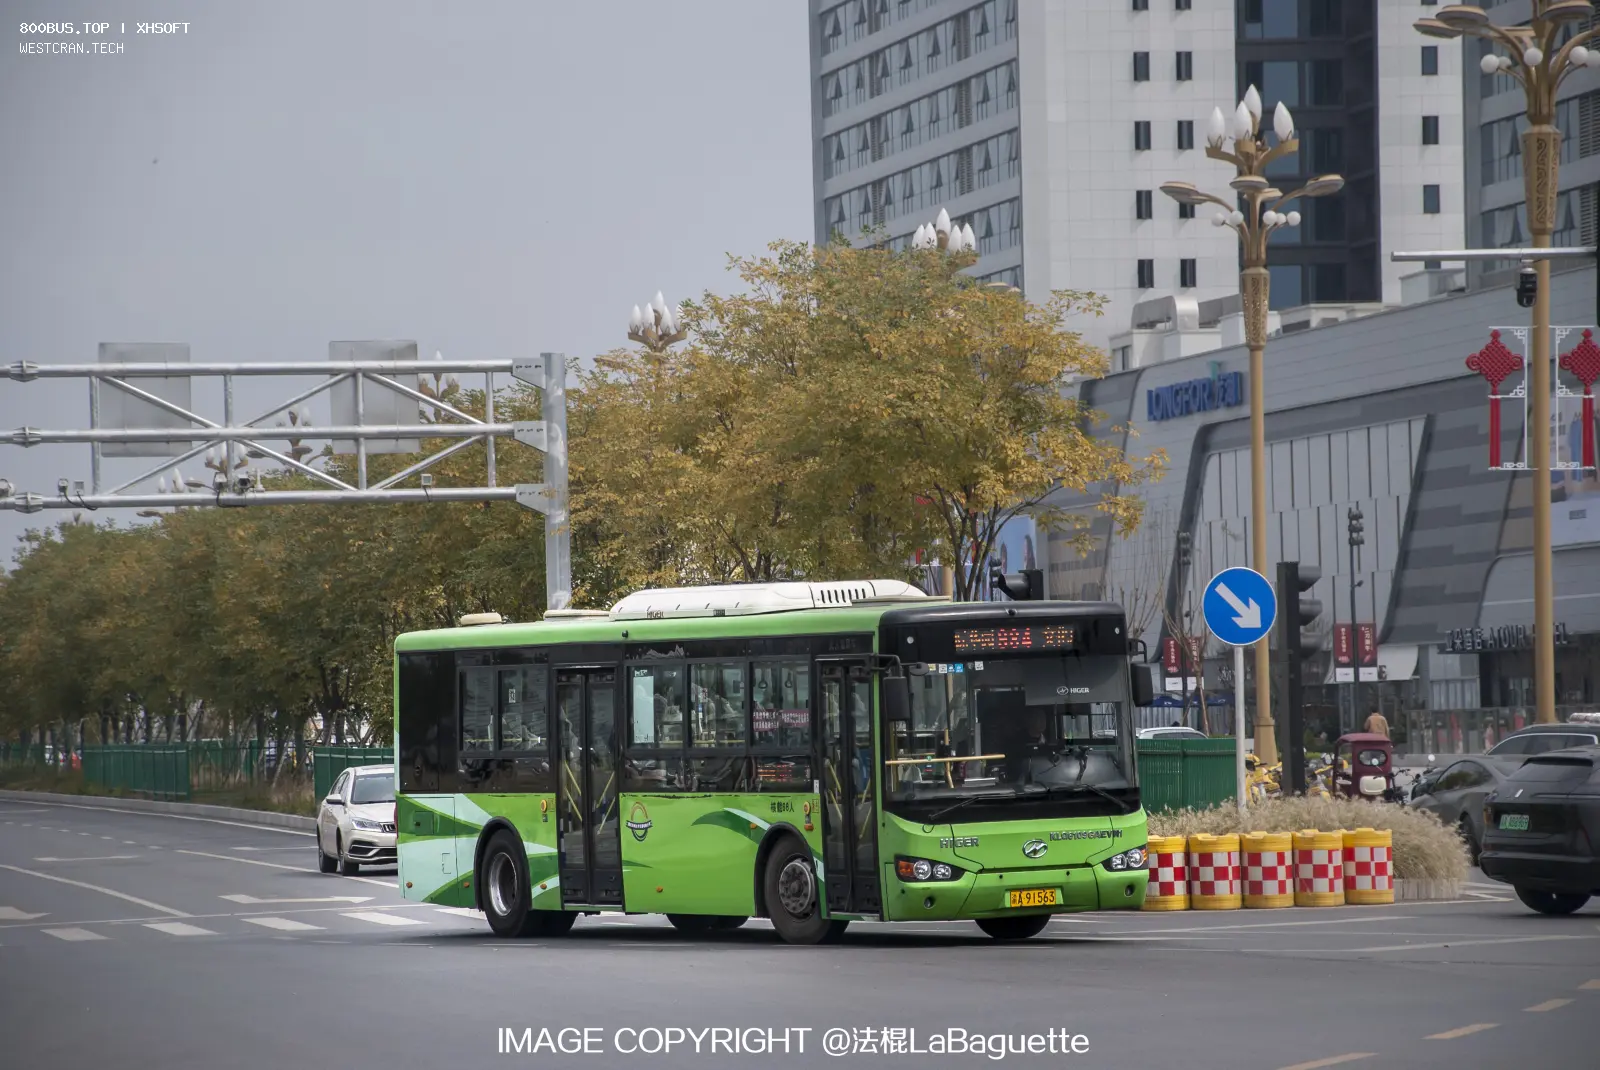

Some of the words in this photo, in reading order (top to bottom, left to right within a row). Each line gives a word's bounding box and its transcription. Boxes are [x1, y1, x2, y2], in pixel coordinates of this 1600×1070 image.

[1147, 377, 1214, 421] LONGFOR
[1487, 624, 1526, 650] ATOUR
[940, 837, 980, 849] HIGER
